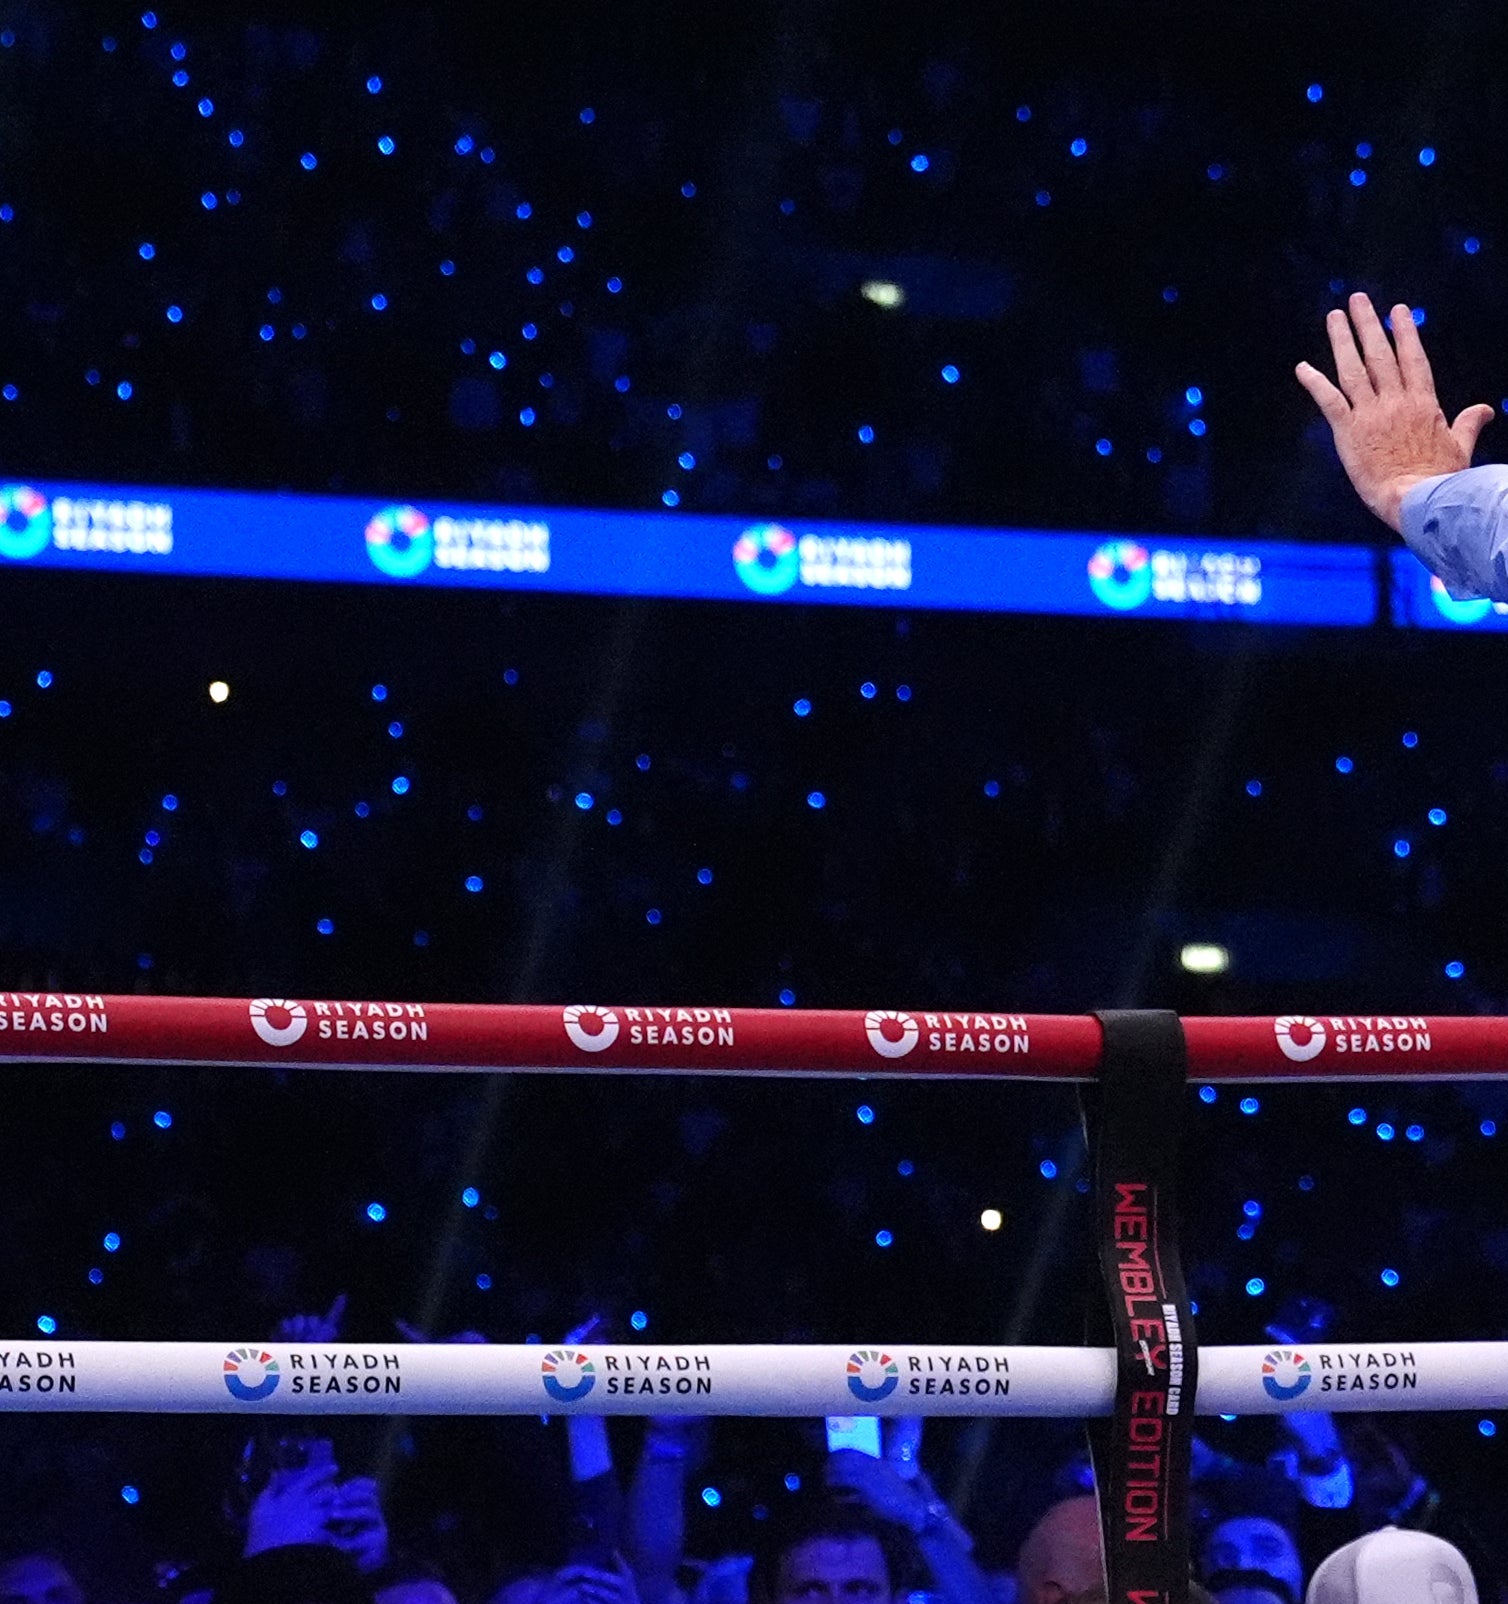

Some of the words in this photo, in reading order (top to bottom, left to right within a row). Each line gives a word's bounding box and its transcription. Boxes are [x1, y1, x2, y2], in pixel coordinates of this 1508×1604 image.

[312, 1001, 425, 1018] RIYADH
[623, 1007, 732, 1023] RIYADH
[318, 1019, 428, 1041] SEASON
[924, 1013, 1028, 1030] RIYADH
[1327, 1016, 1427, 1031] RIYADH
[630, 1025, 734, 1046] SEASON
[929, 1032, 1029, 1054] SEASON
[1335, 1033, 1431, 1053] SEASON
[1113, 1182, 1167, 1371] WEMBLEY
[289, 1353, 400, 1370] RIYADH
[604, 1355, 711, 1371] RIYADH
[908, 1356, 1009, 1373] RIYADH
[1319, 1352, 1416, 1370] RIYADH
[291, 1375, 401, 1394] SEASON
[607, 1376, 712, 1395] SEASON
[909, 1377, 1010, 1396] SEASON
[1320, 1372, 1417, 1392] SEASON
[1123, 1390, 1164, 1542] EDITION
